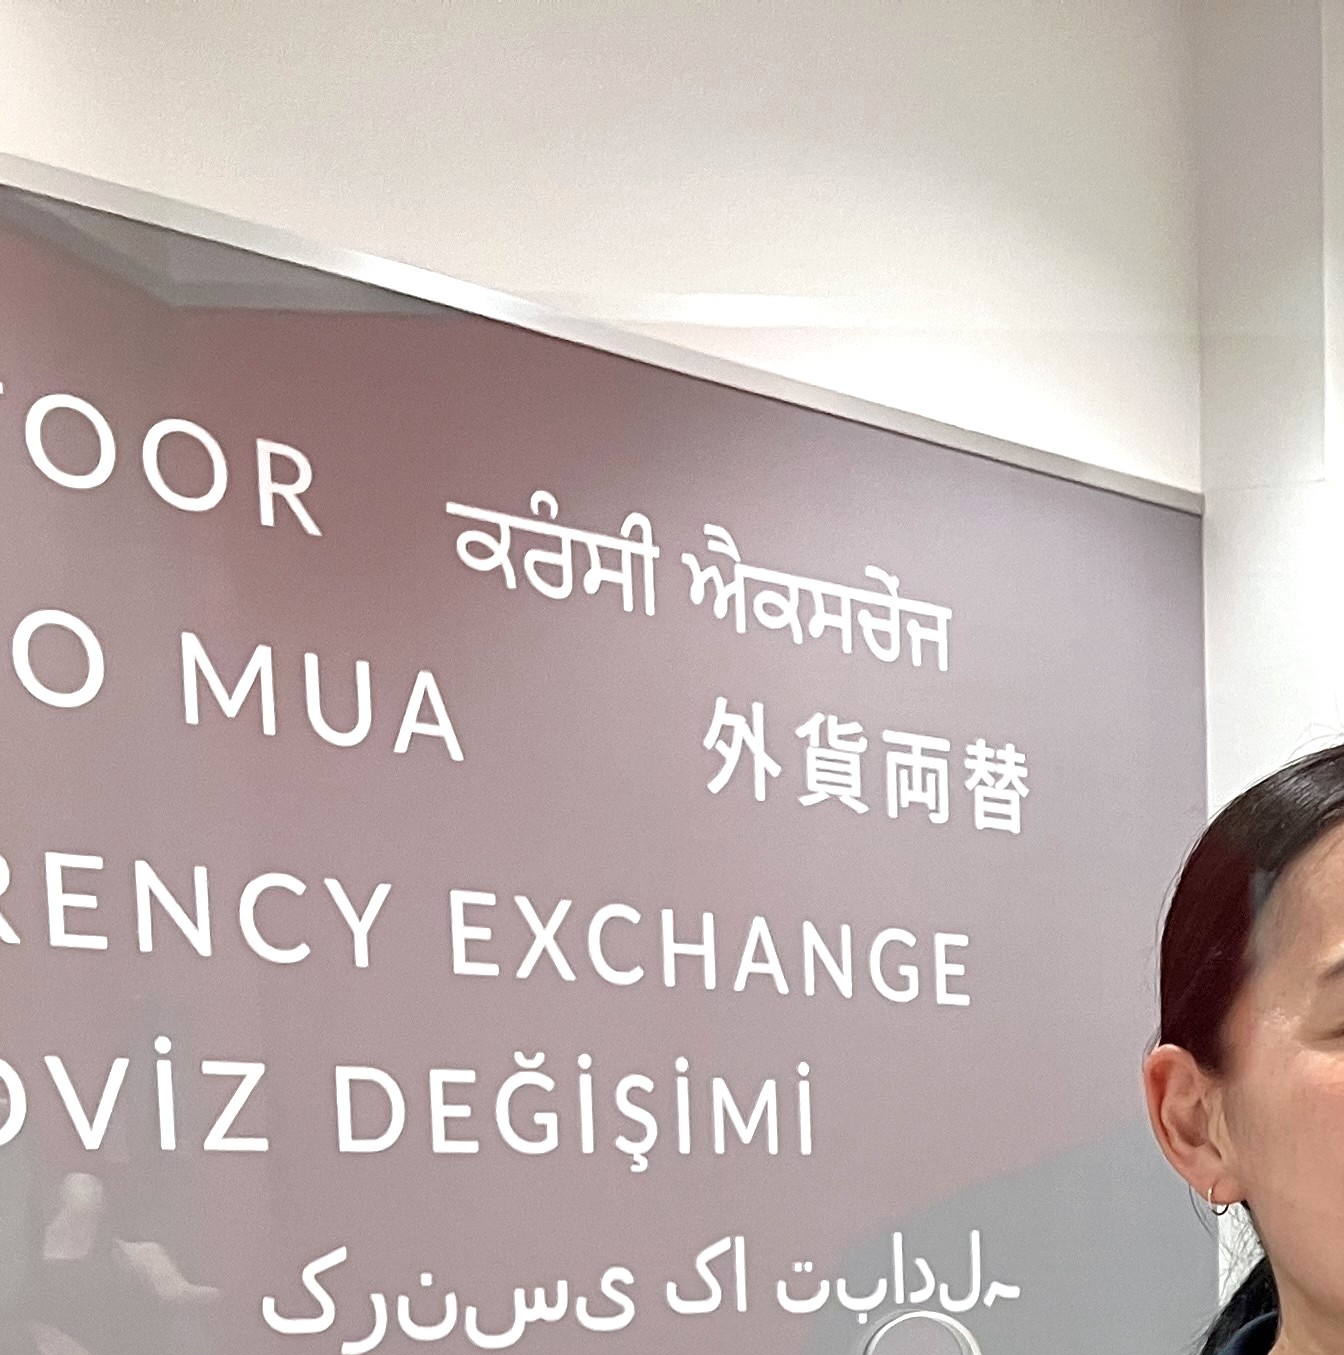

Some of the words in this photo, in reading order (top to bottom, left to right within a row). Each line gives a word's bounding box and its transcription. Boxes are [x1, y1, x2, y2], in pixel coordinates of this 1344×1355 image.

[0, 382, 322, 536] OOR
[181, 631, 464, 762] MUA
[702, 696, 1030, 835] 外貨両替
[449, 889, 971, 1006] EXCHANGE
[335, 1051, 812, 1173] DEĞİŞİMİ
